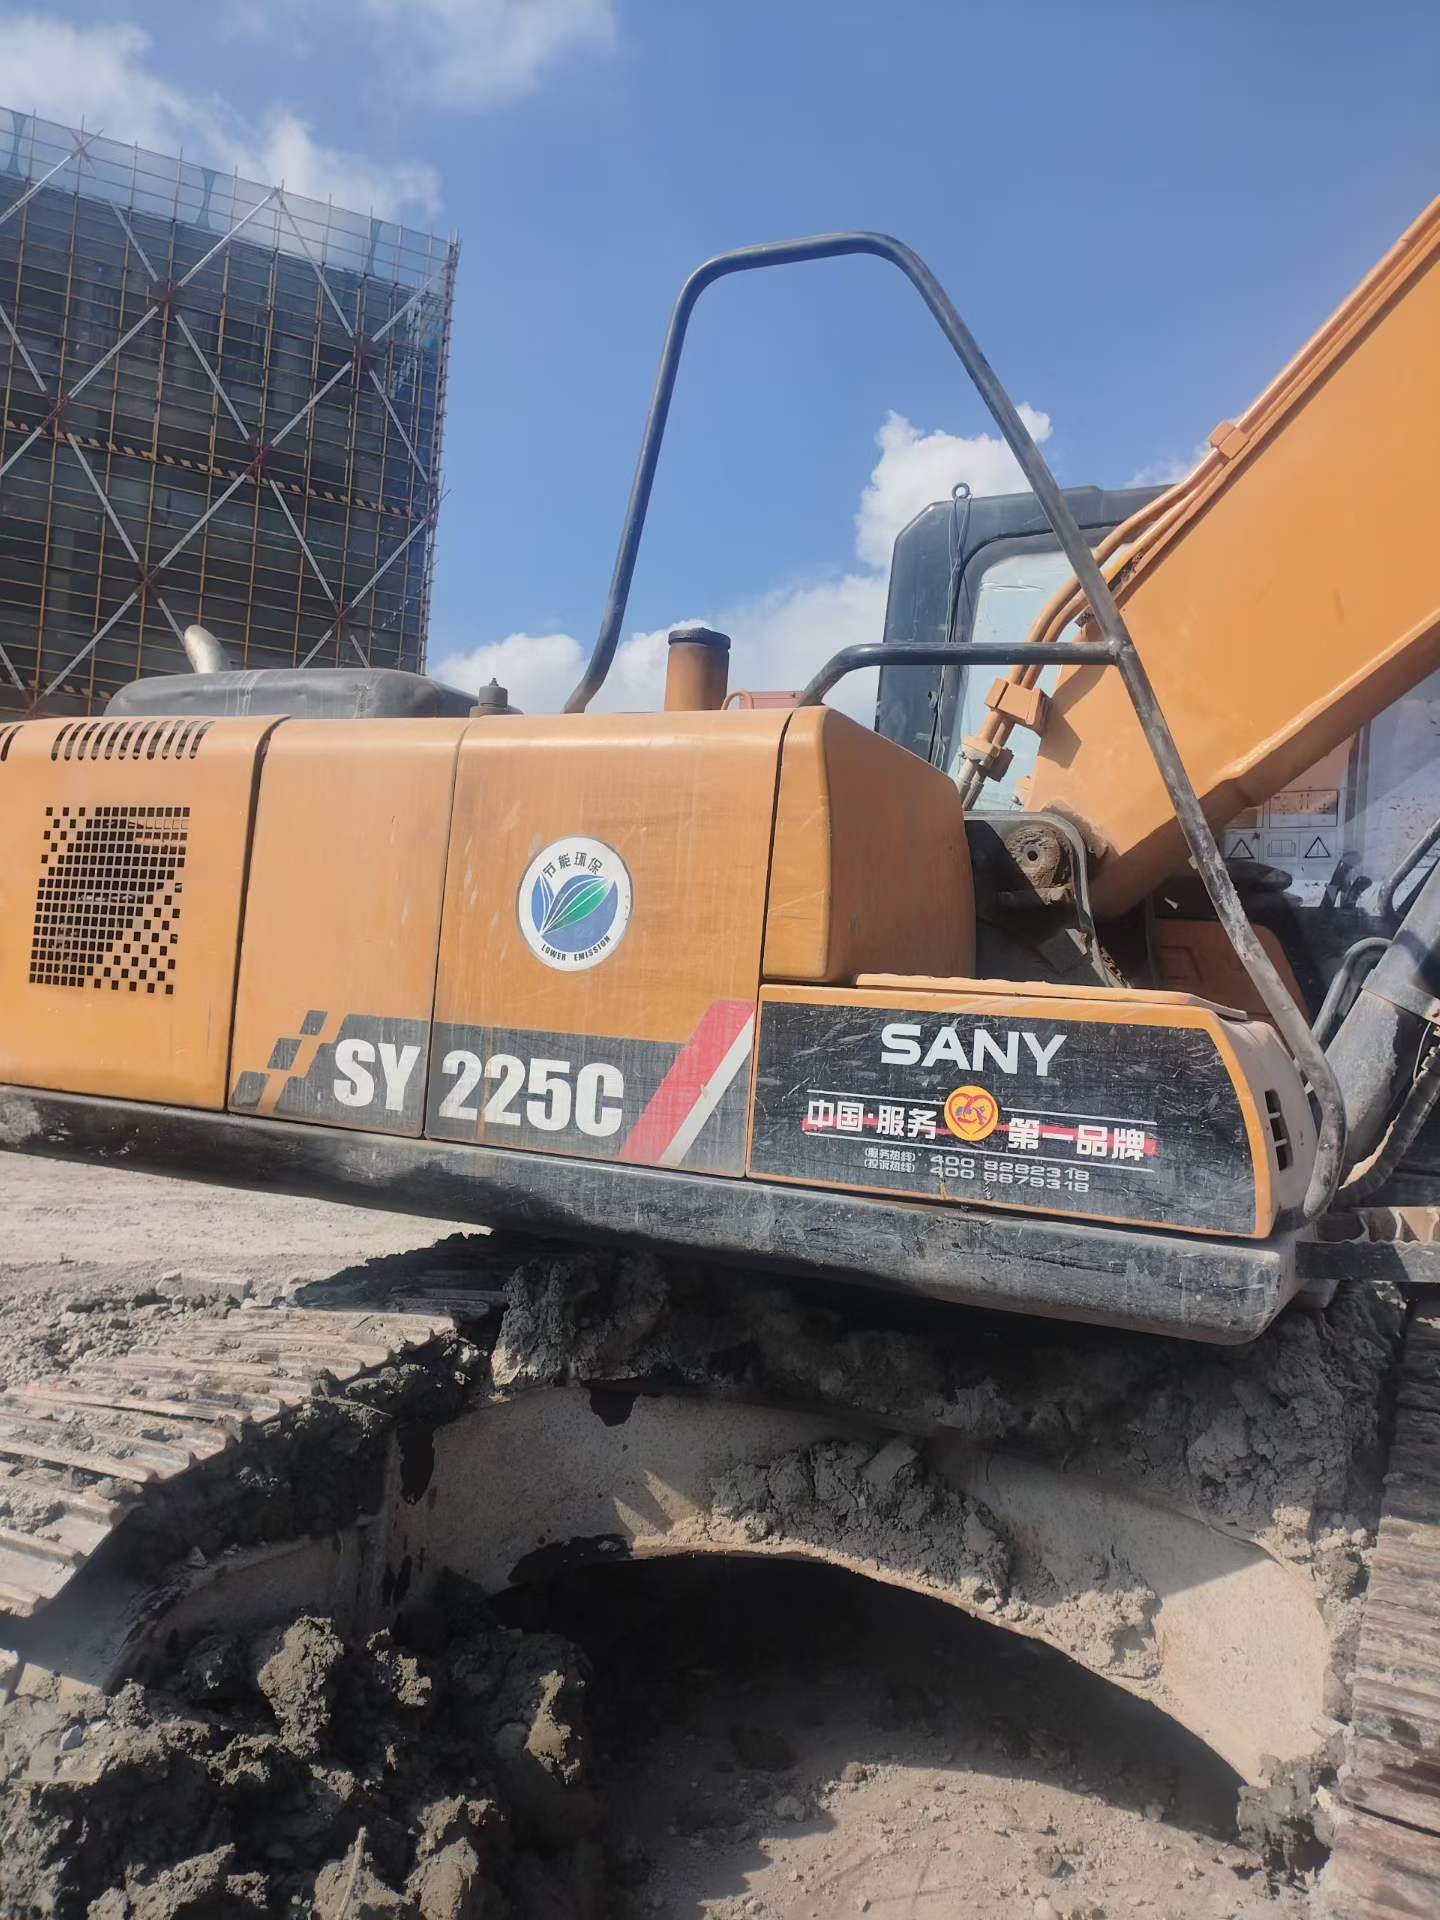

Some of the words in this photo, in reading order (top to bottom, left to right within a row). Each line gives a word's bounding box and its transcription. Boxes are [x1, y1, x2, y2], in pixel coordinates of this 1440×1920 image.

[543, 851, 603, 878] 节能环保
[541, 943, 567, 961] LOWER
[574, 935, 611, 961] EMISSION
[881, 1023, 1068, 1077] SANY
[333, 1039, 422, 1111] SY
[439, 1050, 625, 1138] 225C
[1009, 1117, 1147, 1161] 第一品牌
[930, 1154, 975, 1168] 400
[984, 1160, 1090, 1181] 8282318
[930, 1166, 975, 1179] 400
[984, 1171, 1090, 1193] 8879318
